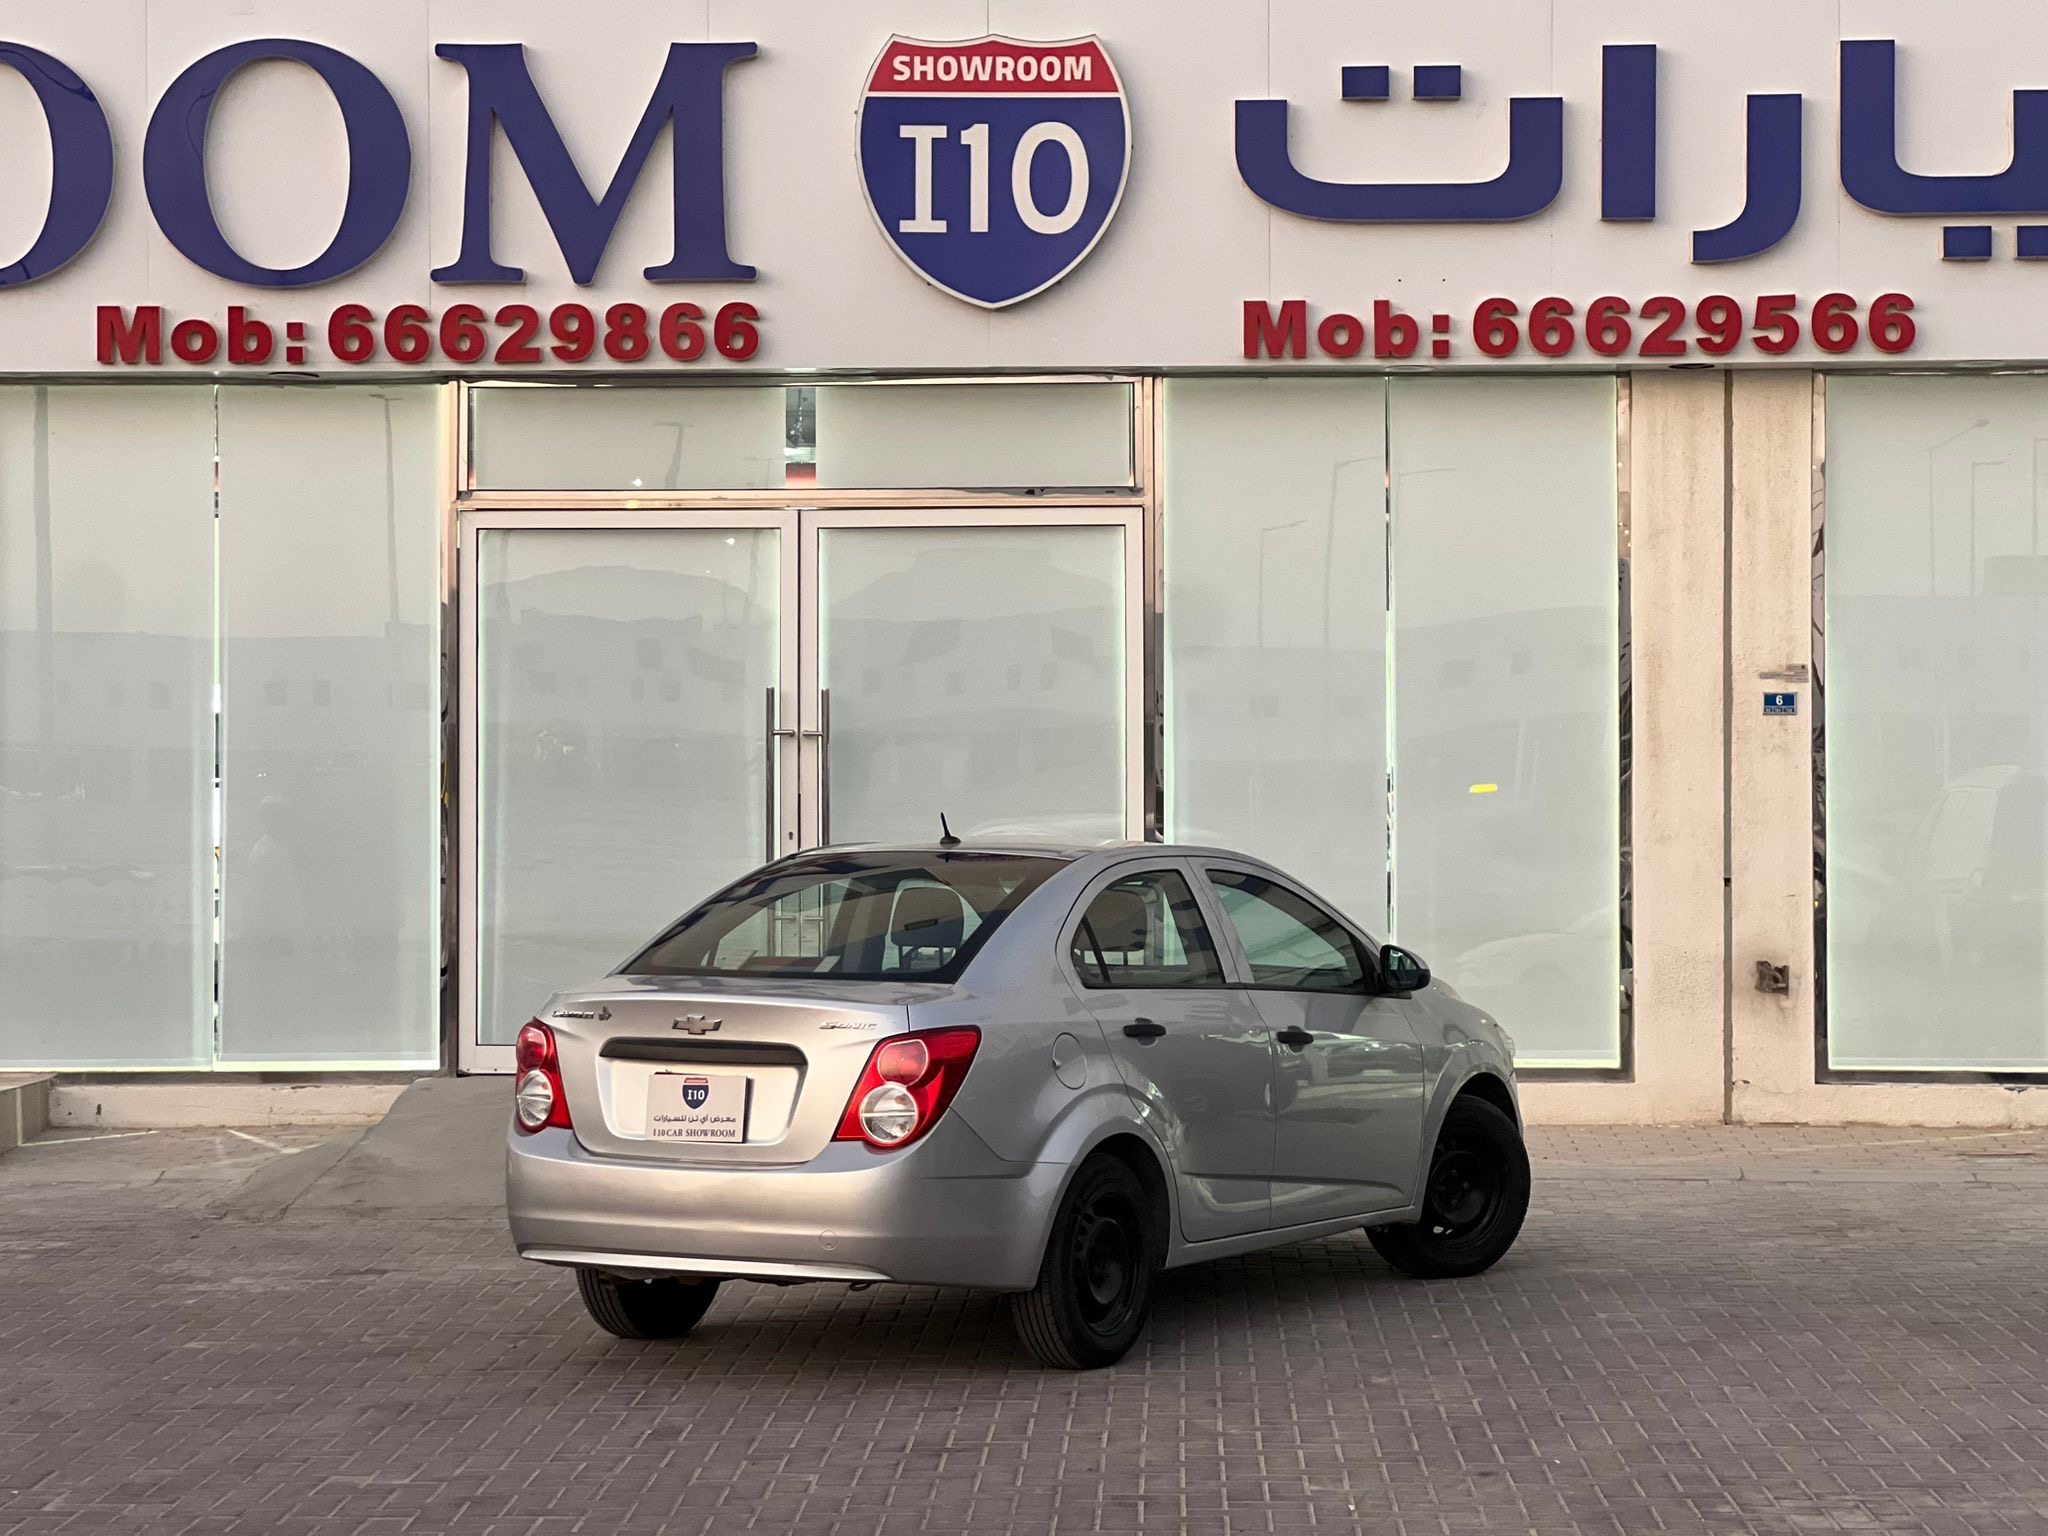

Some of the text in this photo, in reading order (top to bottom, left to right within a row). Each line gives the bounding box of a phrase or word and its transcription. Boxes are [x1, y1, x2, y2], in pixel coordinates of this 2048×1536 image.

[892, 55, 1092, 82] SHOWROOM
[898, 121, 1090, 235] I10
[97, 302, 761, 364] Mob: 66629866
[1243, 293, 1917, 359] Mob: 66629566
[1775, 694, 1783, 705] 6
[687, 1089, 705, 1100] I10
[653, 1114, 687, 1123] للسيارات
[685, 1128, 736, 1138] SHOWROOM
